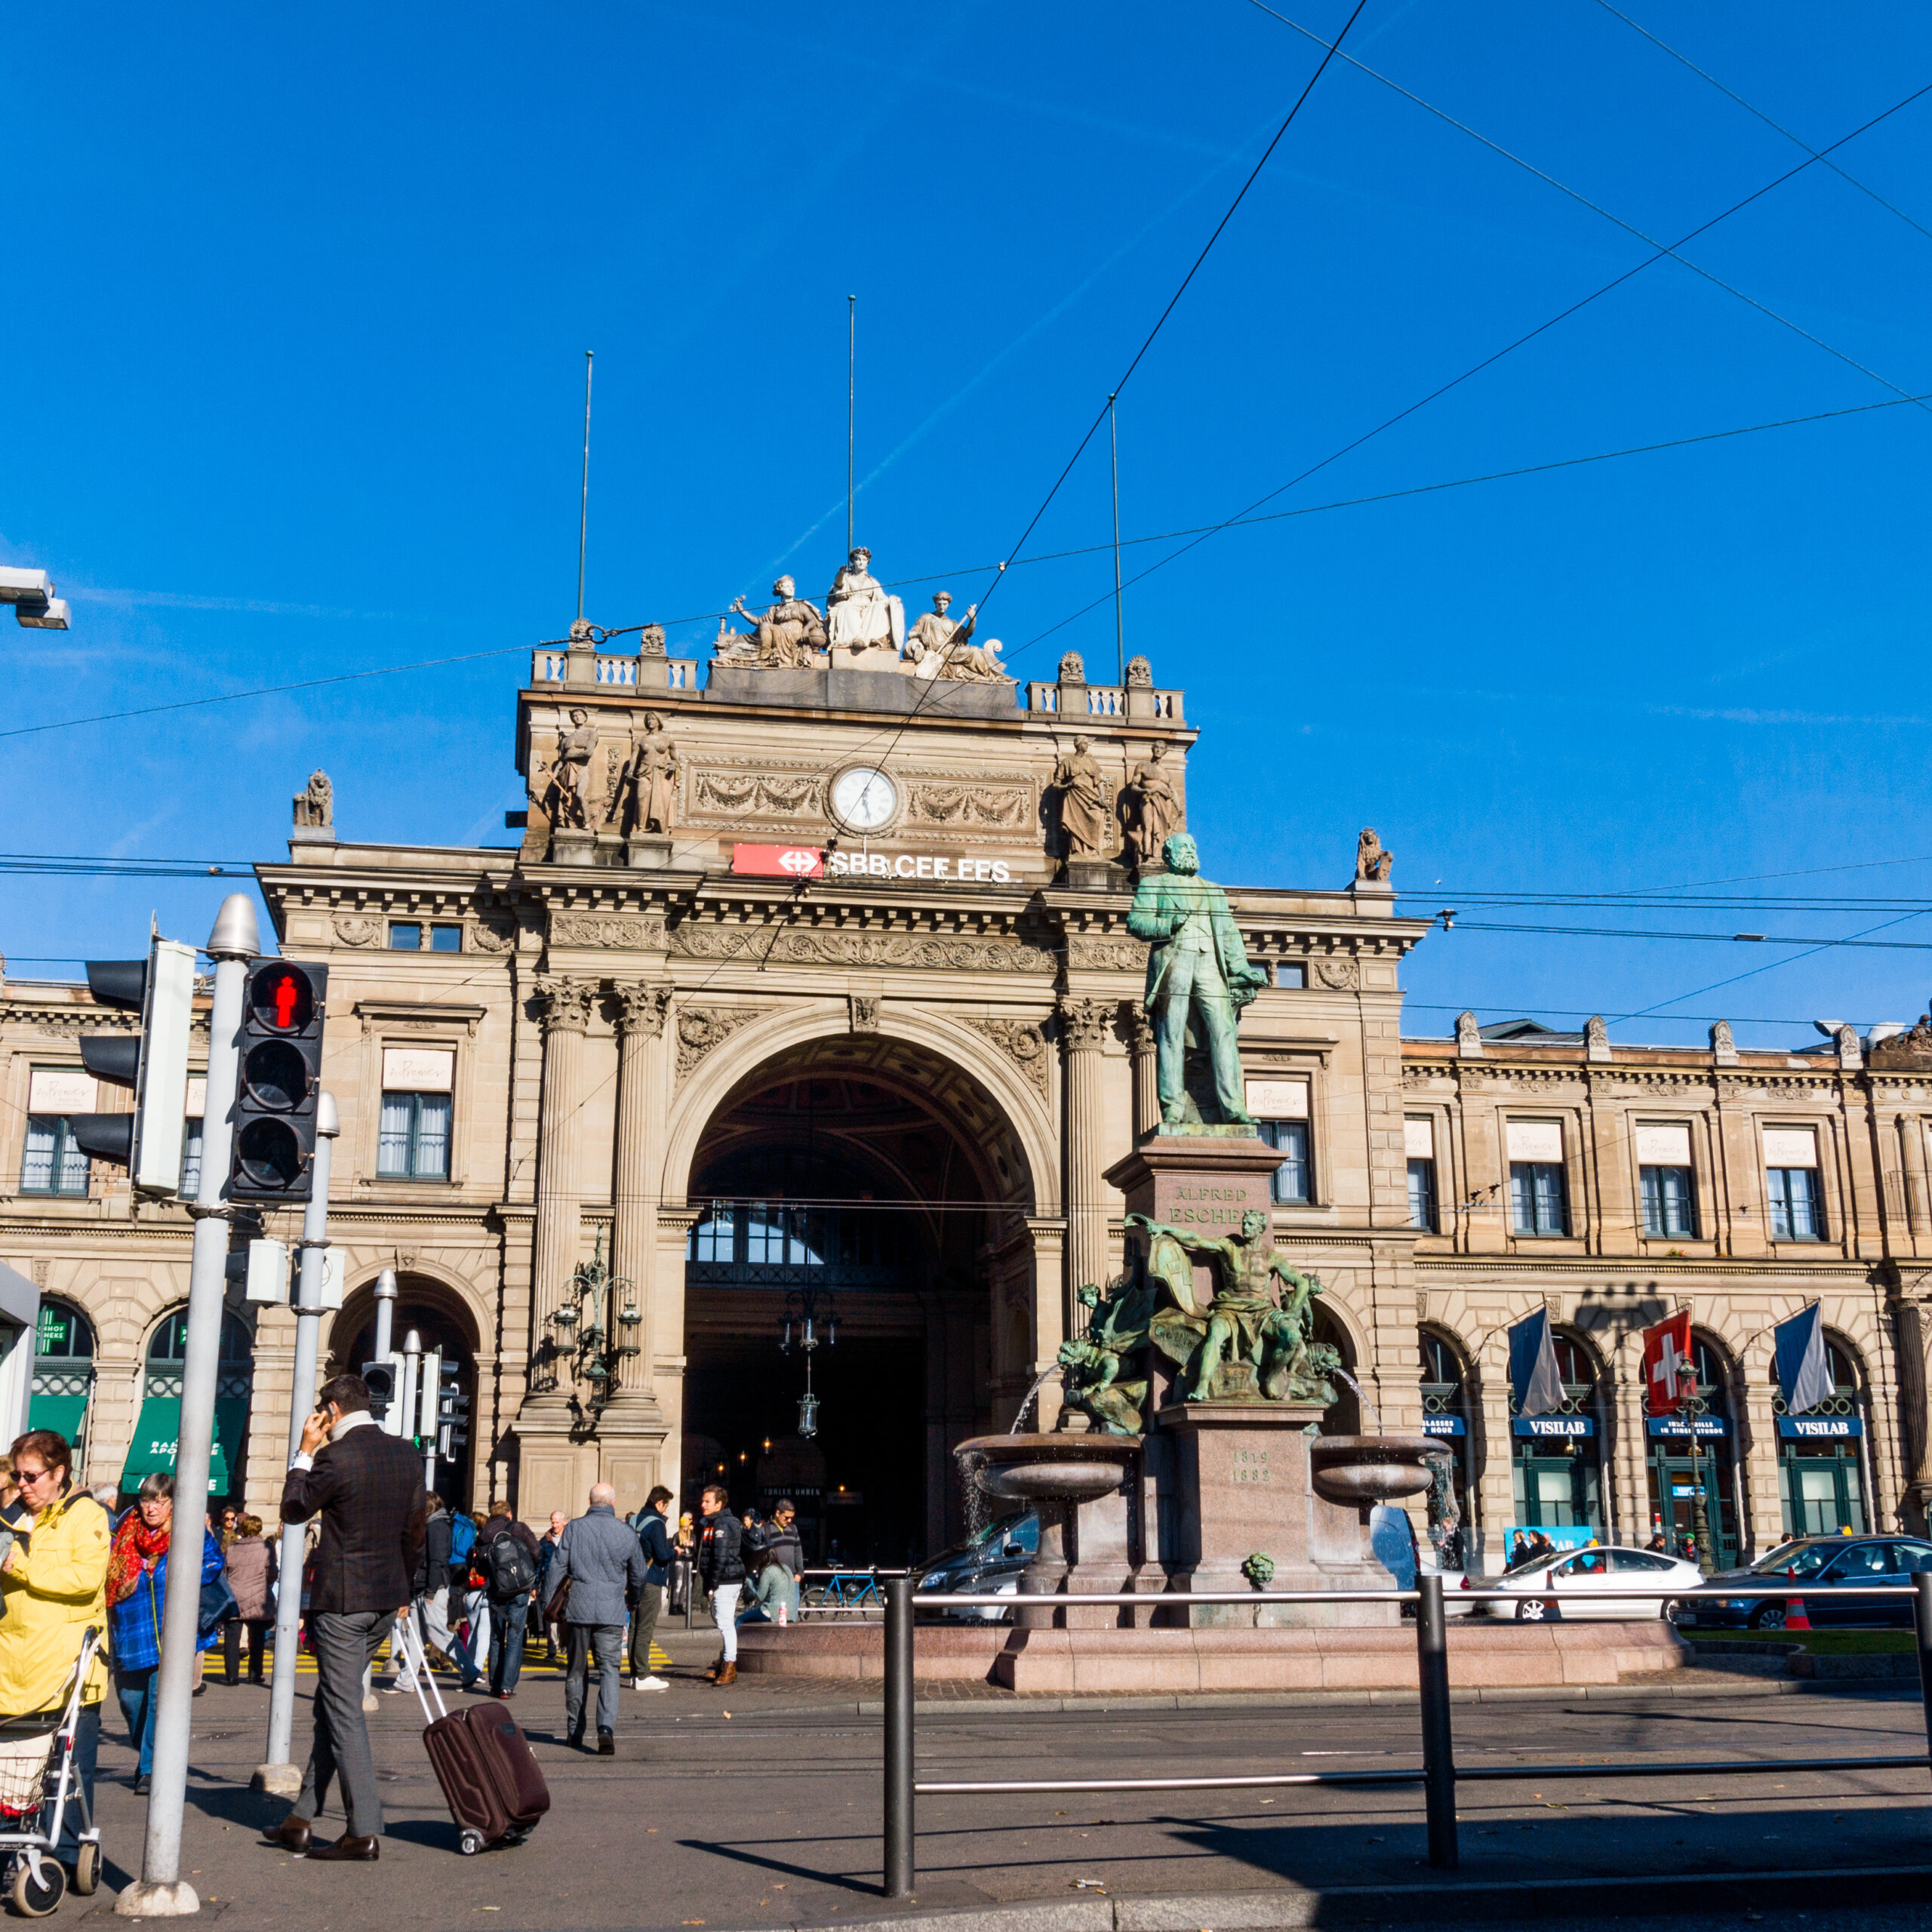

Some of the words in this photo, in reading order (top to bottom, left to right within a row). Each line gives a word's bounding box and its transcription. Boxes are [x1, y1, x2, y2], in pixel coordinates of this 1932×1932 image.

[830, 851, 887, 875] SBB
[894, 854, 951, 879] CFF
[958, 859, 1011, 883] FFS
[1176, 1188, 1248, 1201] ALFRED
[1170, 1208, 1245, 1224] ESCHE
[1530, 1421, 1586, 1434] VISILAB
[1795, 1422, 1849, 1435] VISILAB
[1234, 1451, 1268, 1463] 1819
[1233, 1469, 1269, 1481] 1882
